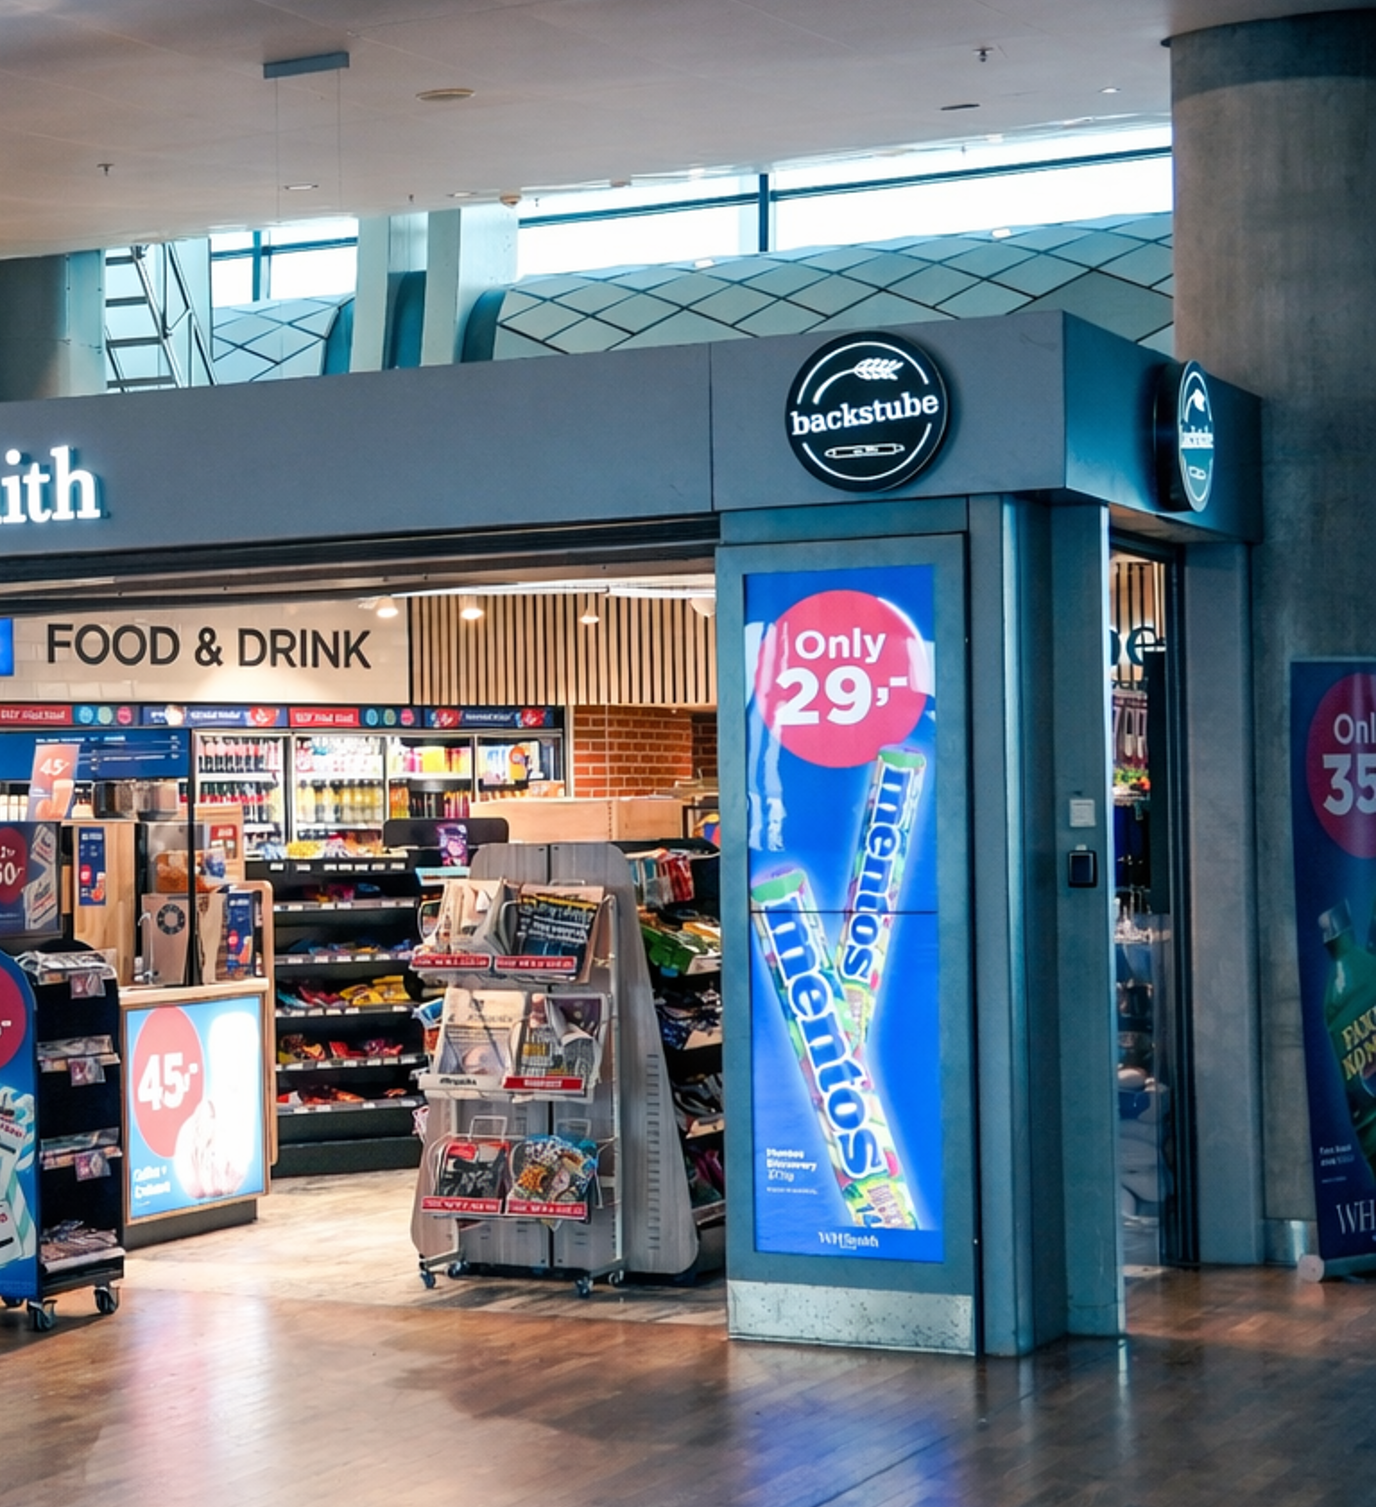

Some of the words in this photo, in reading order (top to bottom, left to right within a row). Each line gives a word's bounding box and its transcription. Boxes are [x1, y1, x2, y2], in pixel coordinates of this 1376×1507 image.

[790, 391, 939, 437] backstube
[47, 624, 180, 665] FOOD
[195, 628, 224, 667] &
[237, 629, 371, 668] DRINK
[795, 628, 886, 664] Only
[776, 665, 908, 726] 29,-
[1333, 711, 1376, 745] Onl
[839, 764, 916, 985] mentos
[762, 891, 888, 1180] mentos
